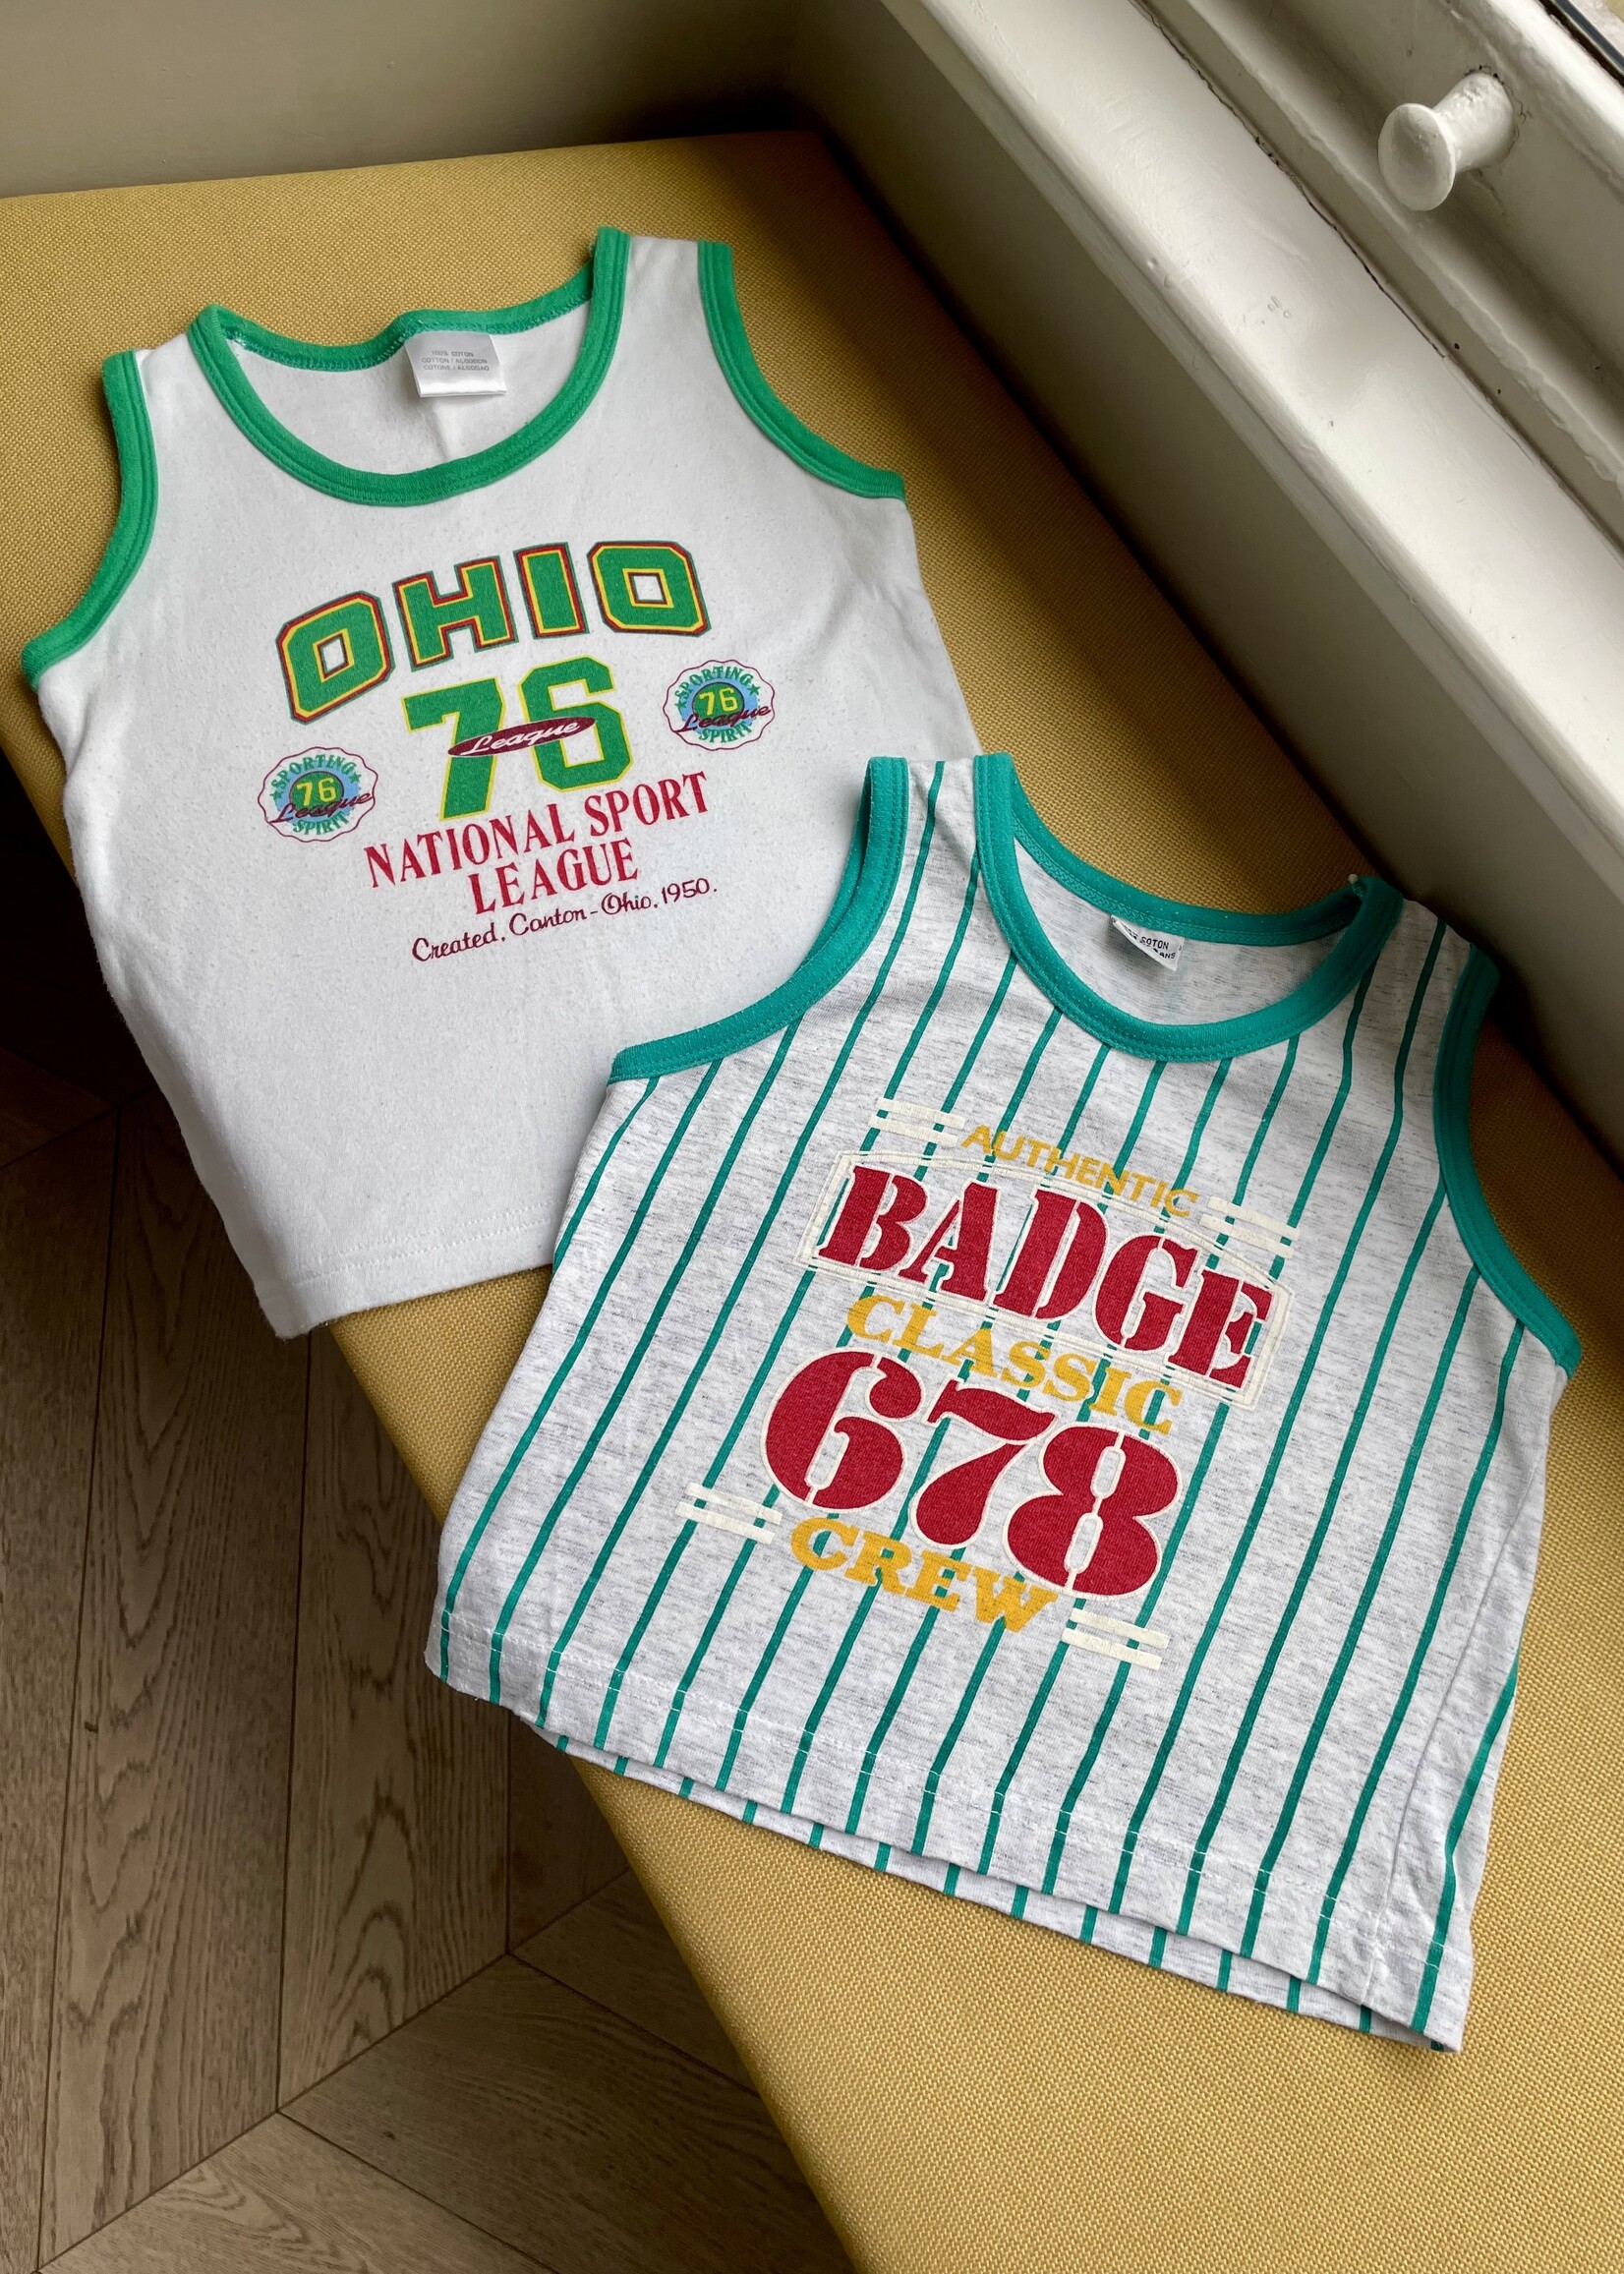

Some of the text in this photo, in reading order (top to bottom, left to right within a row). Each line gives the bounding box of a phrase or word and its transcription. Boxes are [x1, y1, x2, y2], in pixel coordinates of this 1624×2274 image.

[275, 541, 712, 726] OHIO
[673, 706, 772, 733] League
[674, 666, 754, 700] SPORTING
[699, 687, 748, 716] 76
[270, 754, 357, 789] SPORTING
[401, 655, 634, 822] 76
[459, 722, 581, 756] League
[268, 792, 374, 824] League
[296, 777, 336, 806] 76
[364, 771, 709, 888] NATIONAL SPORT
[467, 837, 639, 915] LEAGUE
[960, 1124, 1199, 1217] AUTHENTIC
[818, 1164, 1276, 1388] BADGE
[845, 1294, 1184, 1435] CLASSIC
[761, 1347, 1185, 1601] 678
[790, 1516, 1058, 1634] CREW
